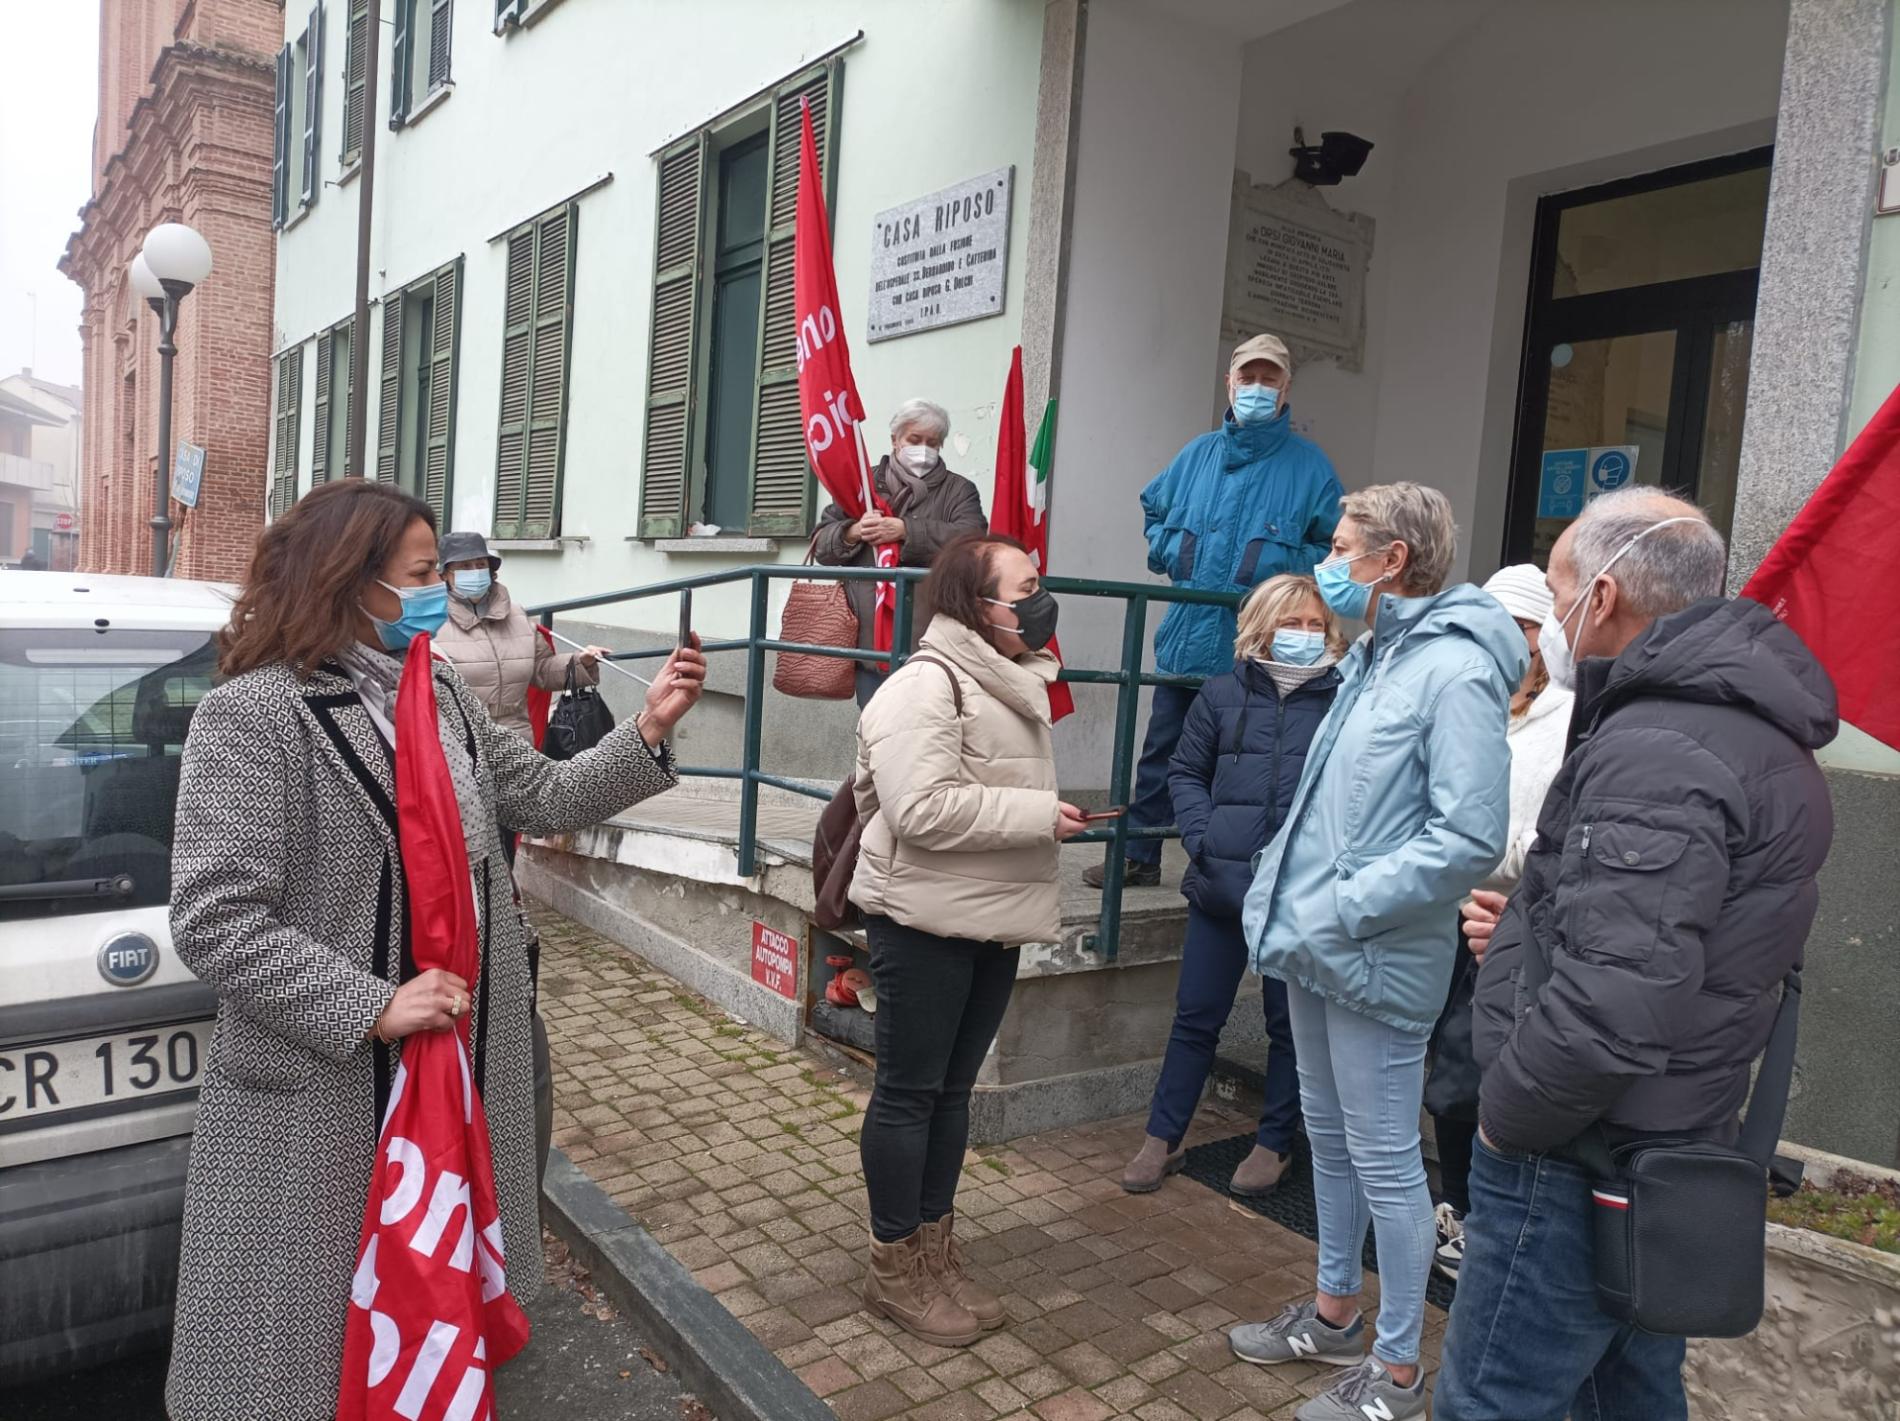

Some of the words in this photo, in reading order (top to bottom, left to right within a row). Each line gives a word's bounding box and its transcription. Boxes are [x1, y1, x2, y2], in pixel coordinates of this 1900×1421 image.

[883, 214, 920, 248] CASA
[935, 188, 994, 233] RIPOSO
[929, 243, 946, 258] DALLA
[950, 235, 973, 252] FUSIONE
[1260, 226, 1281, 240] ORSI
[1282, 233, 1320, 253] GIOVANNI
[1321, 246, 1345, 261] MARIA
[958, 257, 963, 270] E
[922, 284, 942, 299] RIPOSO
[761, 928, 789, 955] ATTACCO
[108, 948, 149, 969] FIAT
[755, 946, 793, 977] AUTOPOMPA
[95, 1030, 198, 1096] 130
[1287, 1332, 1319, 1357] N
[1360, 1396, 1395, 1421] N
